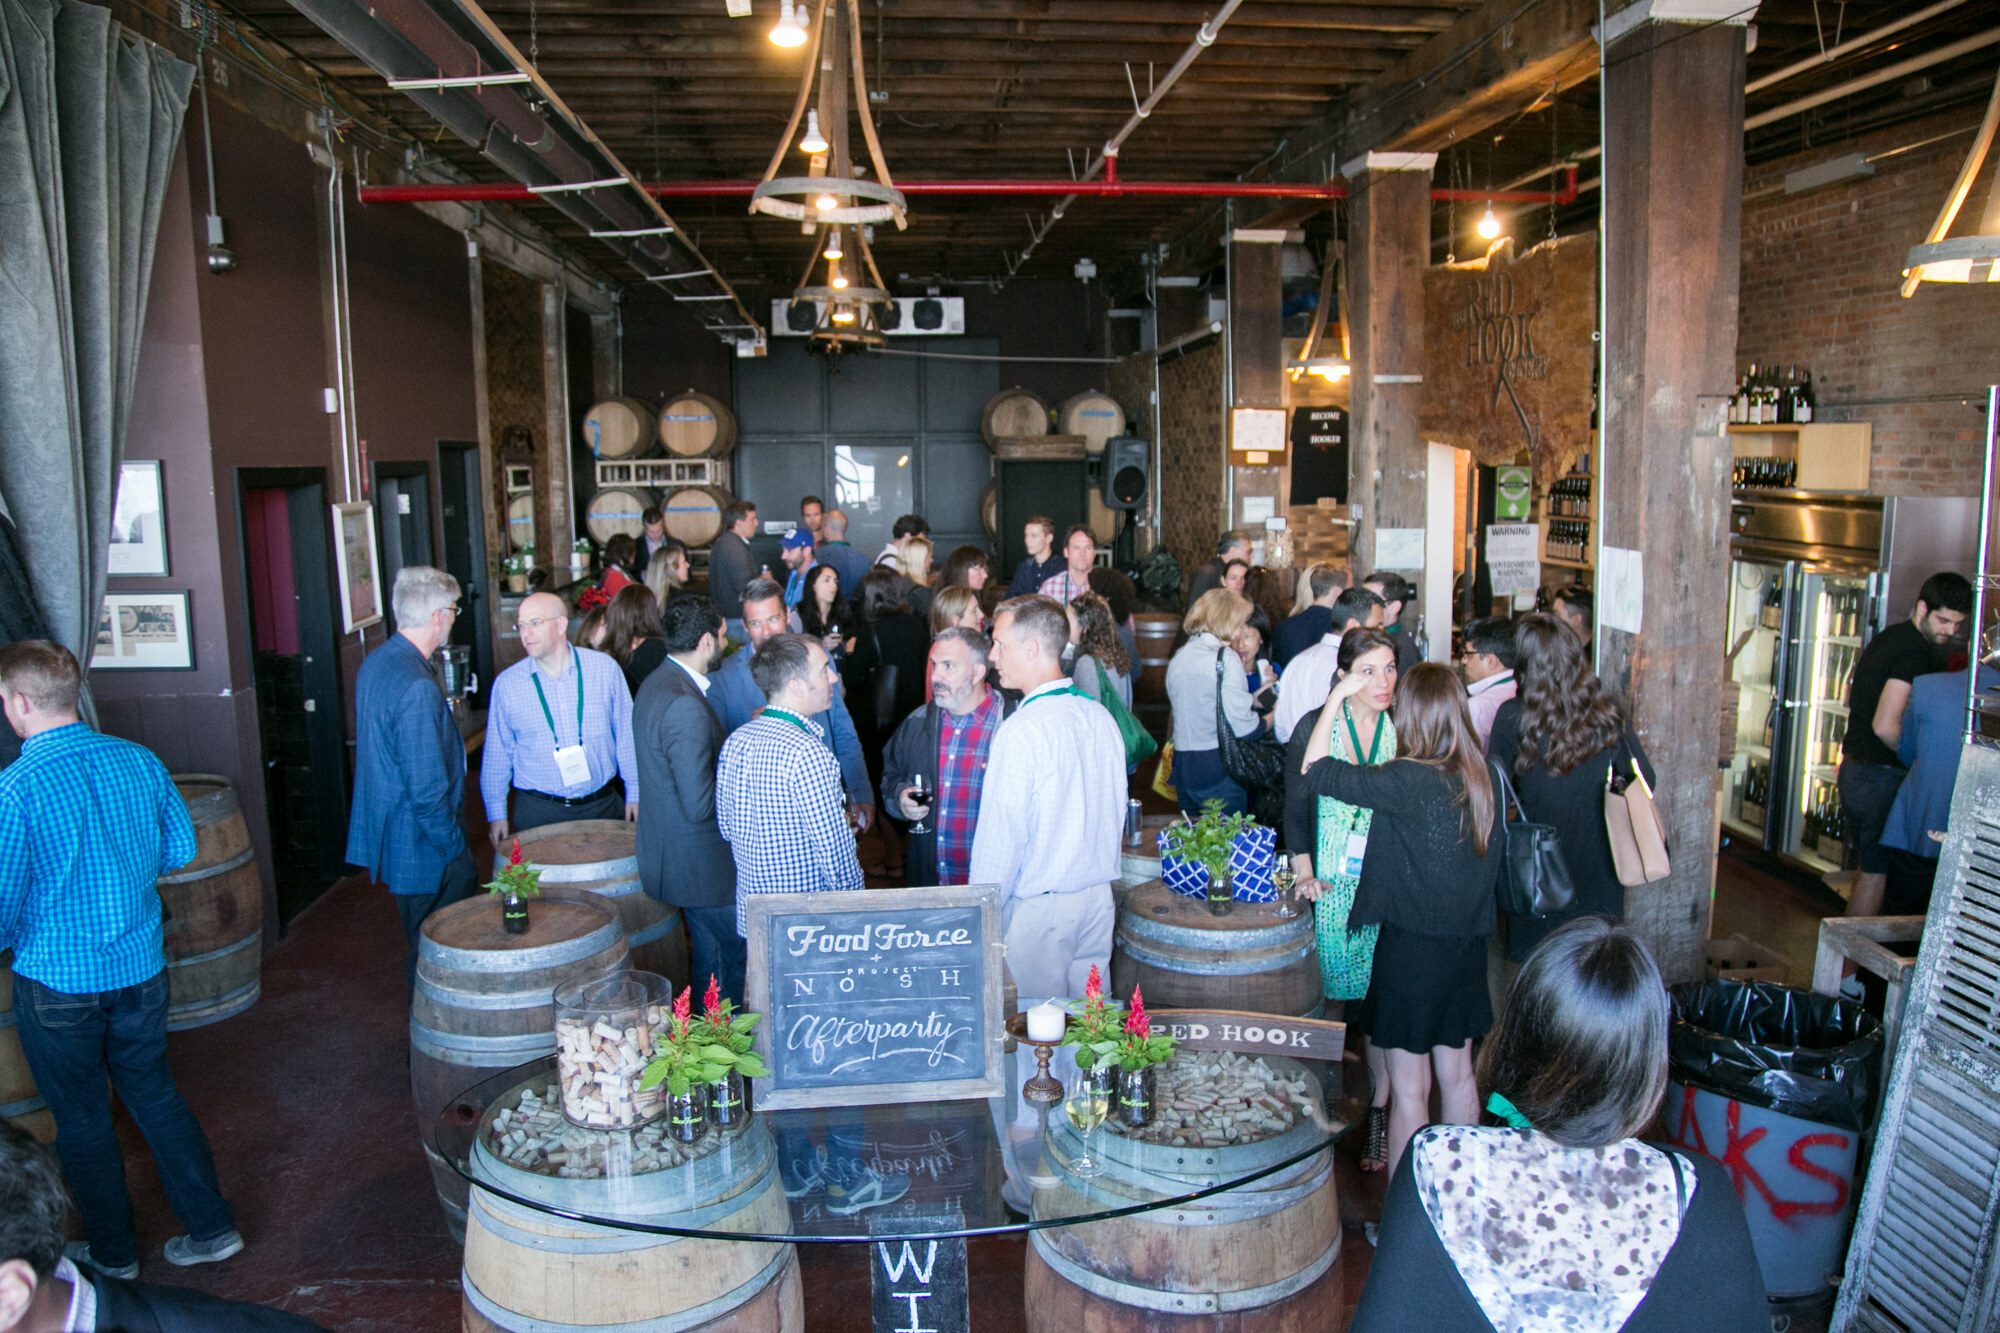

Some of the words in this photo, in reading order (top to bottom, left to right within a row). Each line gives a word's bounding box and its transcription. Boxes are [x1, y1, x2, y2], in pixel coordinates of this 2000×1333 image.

[1466, 312, 1537, 367] HOOK
[1310, 412, 1341, 420] BECOME
[1322, 422, 1329, 430] A
[1310, 435, 1341, 444] HOOKER
[1491, 526, 1531, 537] WARNING
[1491, 561, 1535, 569] GOVERNMENT
[787, 924, 872, 957] Food
[874, 923, 972, 950] Force
[847, 966, 918, 975] PROJECT
[787, 1011, 973, 1067] Afterparty
[1221, 1024, 1312, 1048] HOOK
